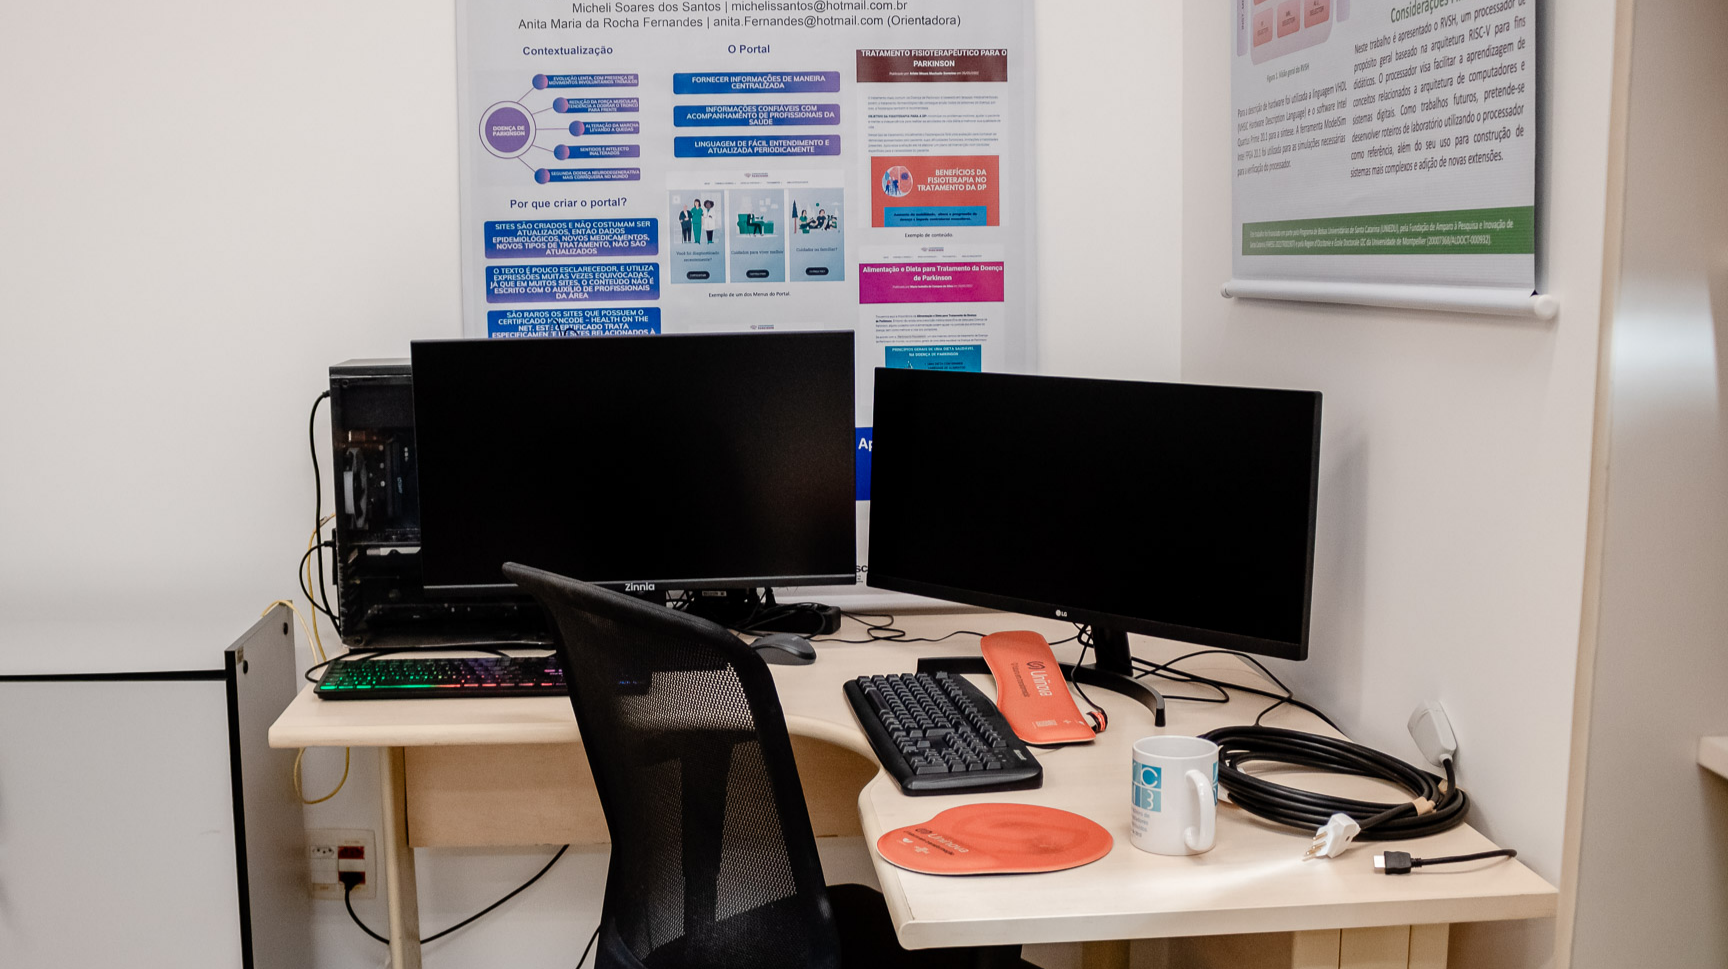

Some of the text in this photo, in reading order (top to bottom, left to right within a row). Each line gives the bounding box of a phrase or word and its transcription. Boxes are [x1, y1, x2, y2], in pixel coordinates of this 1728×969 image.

[572, 3, 611, 13] Micheli
[615, 3, 654, 12] Soares
[658, 2, 678, 12] dos
[682, 2, 720, 12] Santos
[518, 19, 546, 29] Anita
[550, 19, 581, 29] Maria
[585, 19, 599, 28] da
[603, 18, 638, 28] Rocha
[643, 18, 702, 28] Fernandes
[728, 44, 770, 54] O Portal
[730, 75, 781, 83] INFORMAÇÕES
[510, 199, 527, 208] Por
[531, 201, 550, 210] que
[553, 199, 577, 208] criar
[590, 197, 627, 209] portal?
[625, 582, 655, 591] Zinnia
